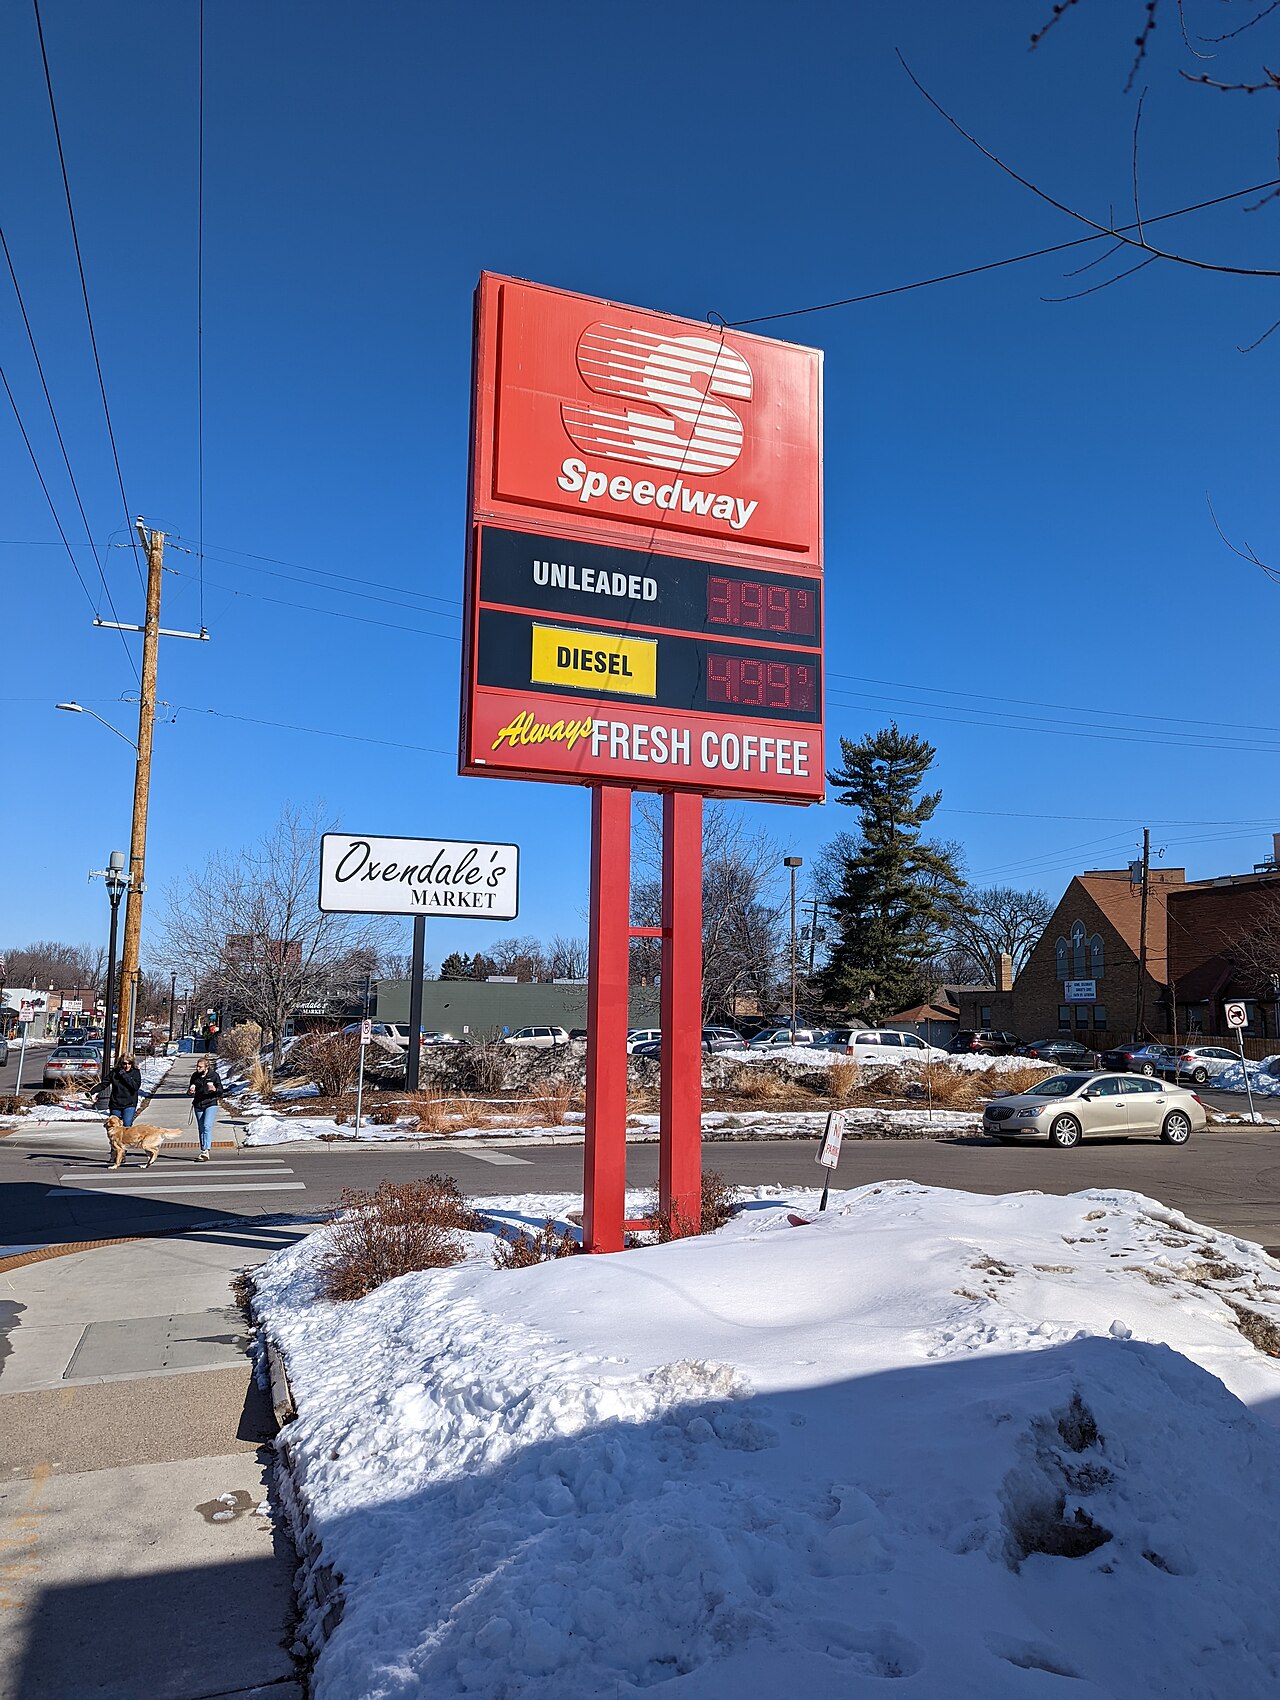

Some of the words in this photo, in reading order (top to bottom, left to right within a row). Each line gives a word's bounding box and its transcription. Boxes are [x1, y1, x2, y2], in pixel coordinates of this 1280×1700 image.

[557, 457, 758, 529] Speedway
[533, 560, 658, 601] UNLEADED
[710, 577, 789, 631] 3.99
[557, 646, 632, 676] DIESEL
[708, 657, 789, 708] 4.99
[491, 710, 596, 750] Always
[591, 719, 691, 765] FRESH
[701, 731, 810, 776] COFFEE
[335, 841, 507, 887] Oxendale's
[410, 889, 497, 909] MARKET
